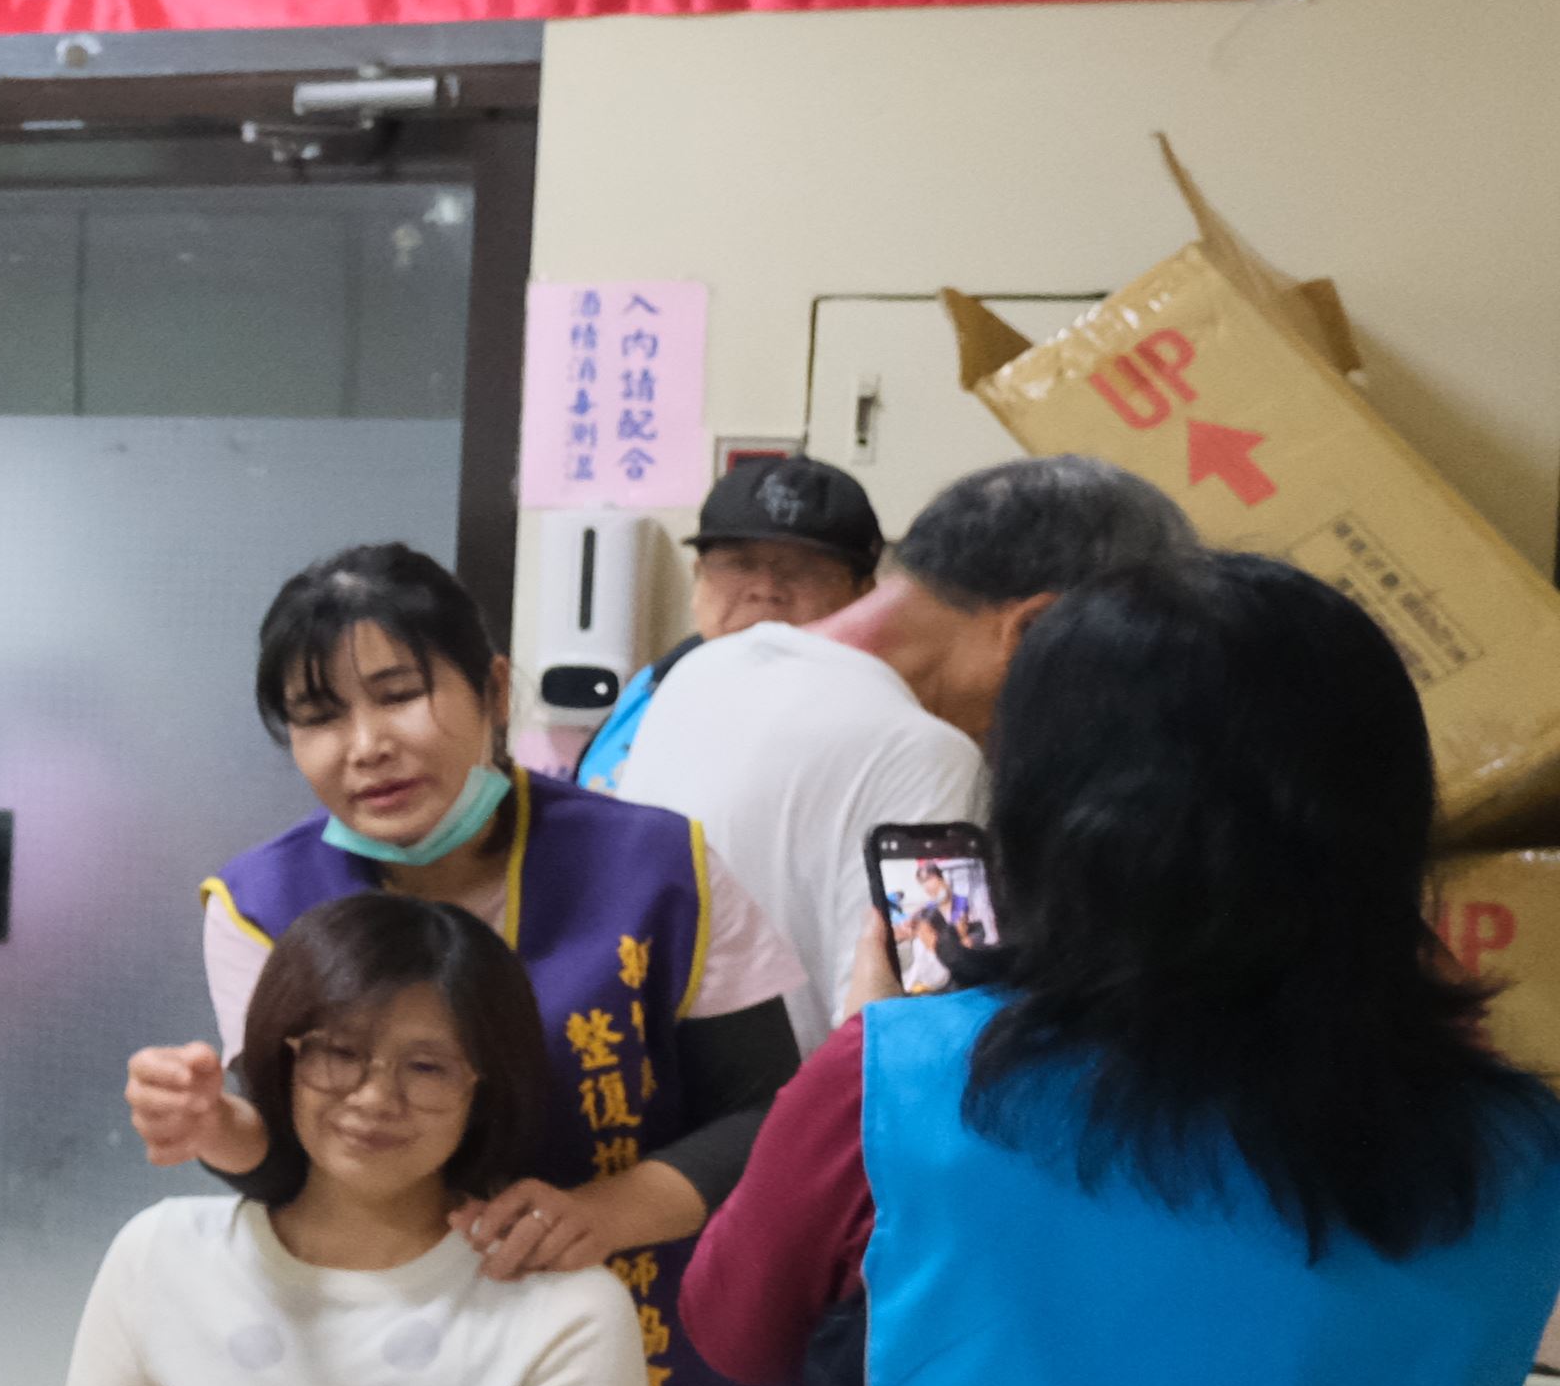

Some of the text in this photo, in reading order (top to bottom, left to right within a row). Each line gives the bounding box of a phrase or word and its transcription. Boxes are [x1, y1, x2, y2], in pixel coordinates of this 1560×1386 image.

[618, 293, 661, 481] 入內請配合
[1089, 328, 1199, 430] UP
